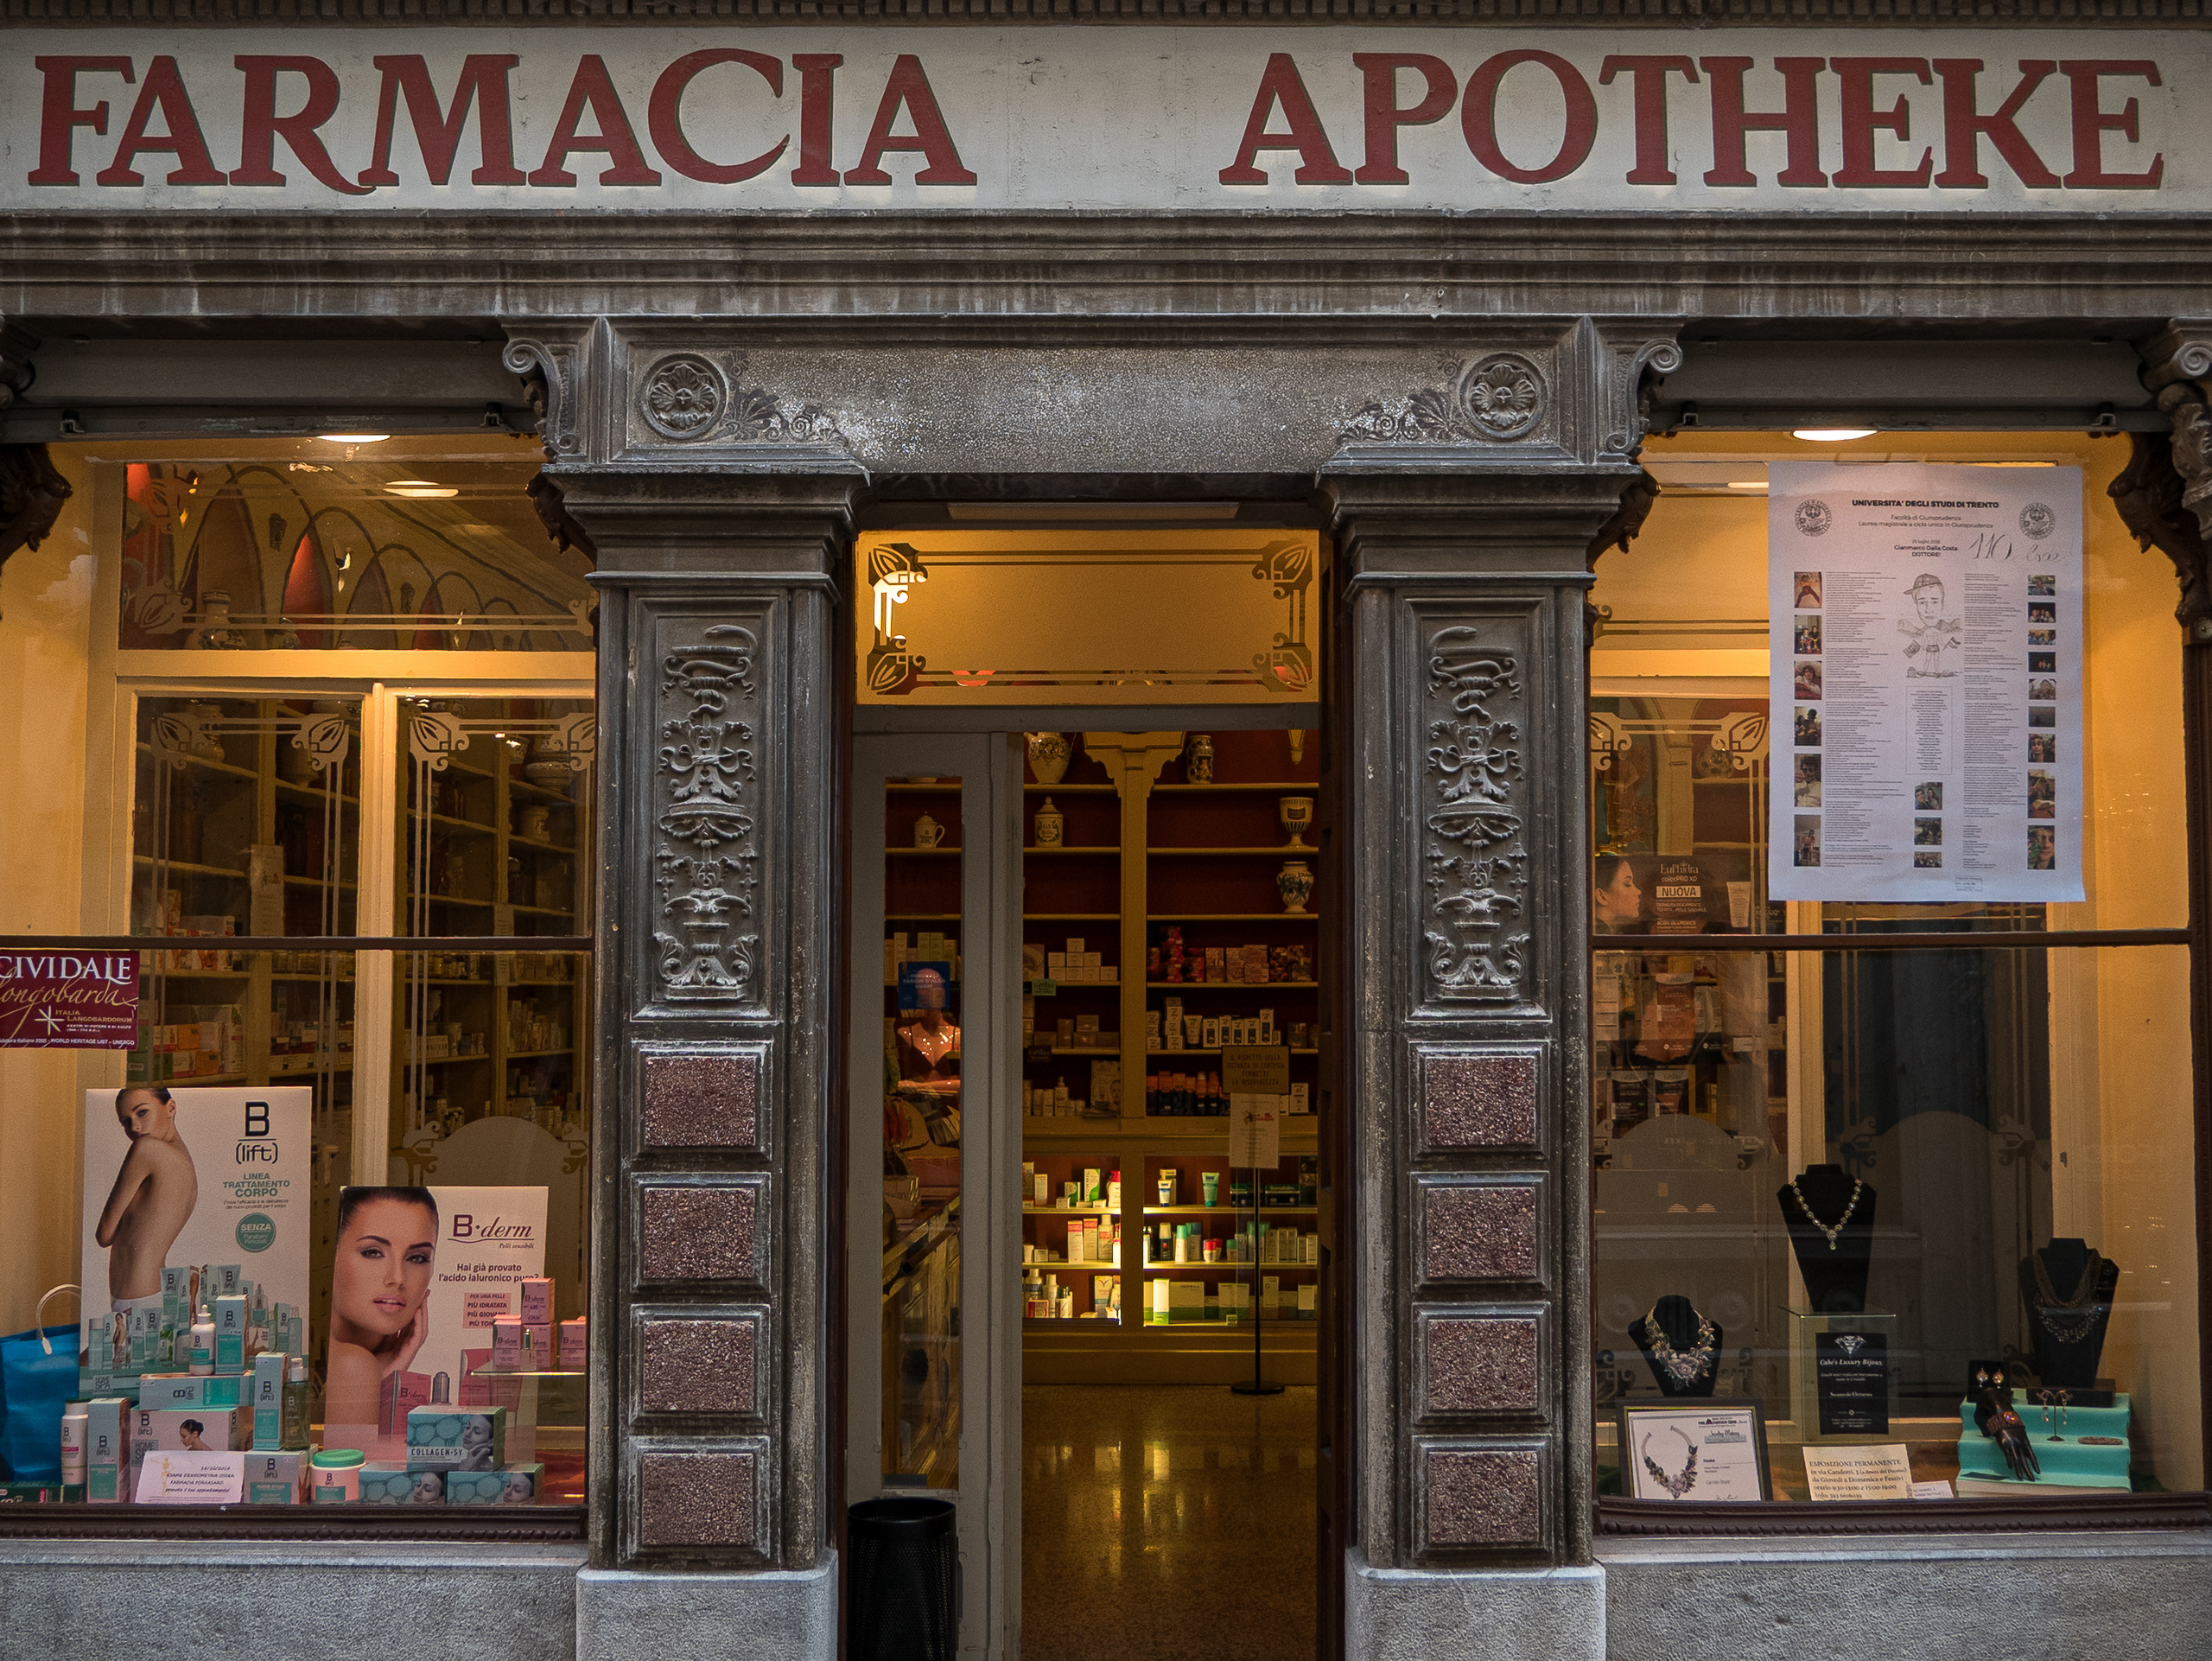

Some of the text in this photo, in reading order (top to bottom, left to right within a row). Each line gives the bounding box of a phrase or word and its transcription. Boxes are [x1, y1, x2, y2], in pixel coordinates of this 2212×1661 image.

[28, 48, 2164, 194] FARMACIA APOTHEKE
[1662, 887, 1697, 897] NUOVA
[0, 956, 132, 985] CIVIDALE
[245, 1101, 270, 1137] B
[236, 1142, 279, 1165] (lift)
[222, 1180, 290, 1189] TRATTAMENTO
[235, 1187, 278, 1198] CORPO
[240, 1223, 271, 1231] SENZA
[457, 1263, 522, 1275] Hai già provato
[168, 1273, 175, 1284] B
[226, 1270, 232, 1282] B
[469, 1273, 512, 1282] ialuronico
[149, 1313, 156, 1323] B
[226, 1310, 233, 1321] B
[1862, 1359, 1883, 1367] Bijoux
[94, 1381, 111, 1390] SPA
[263, 1381, 272, 1393] B
[288, 1396, 296, 1406] B
[141, 1413, 150, 1426] B
[99, 1435, 107, 1448] B
[267, 1458, 276, 1470] B
[327, 1473, 333, 1481] B
